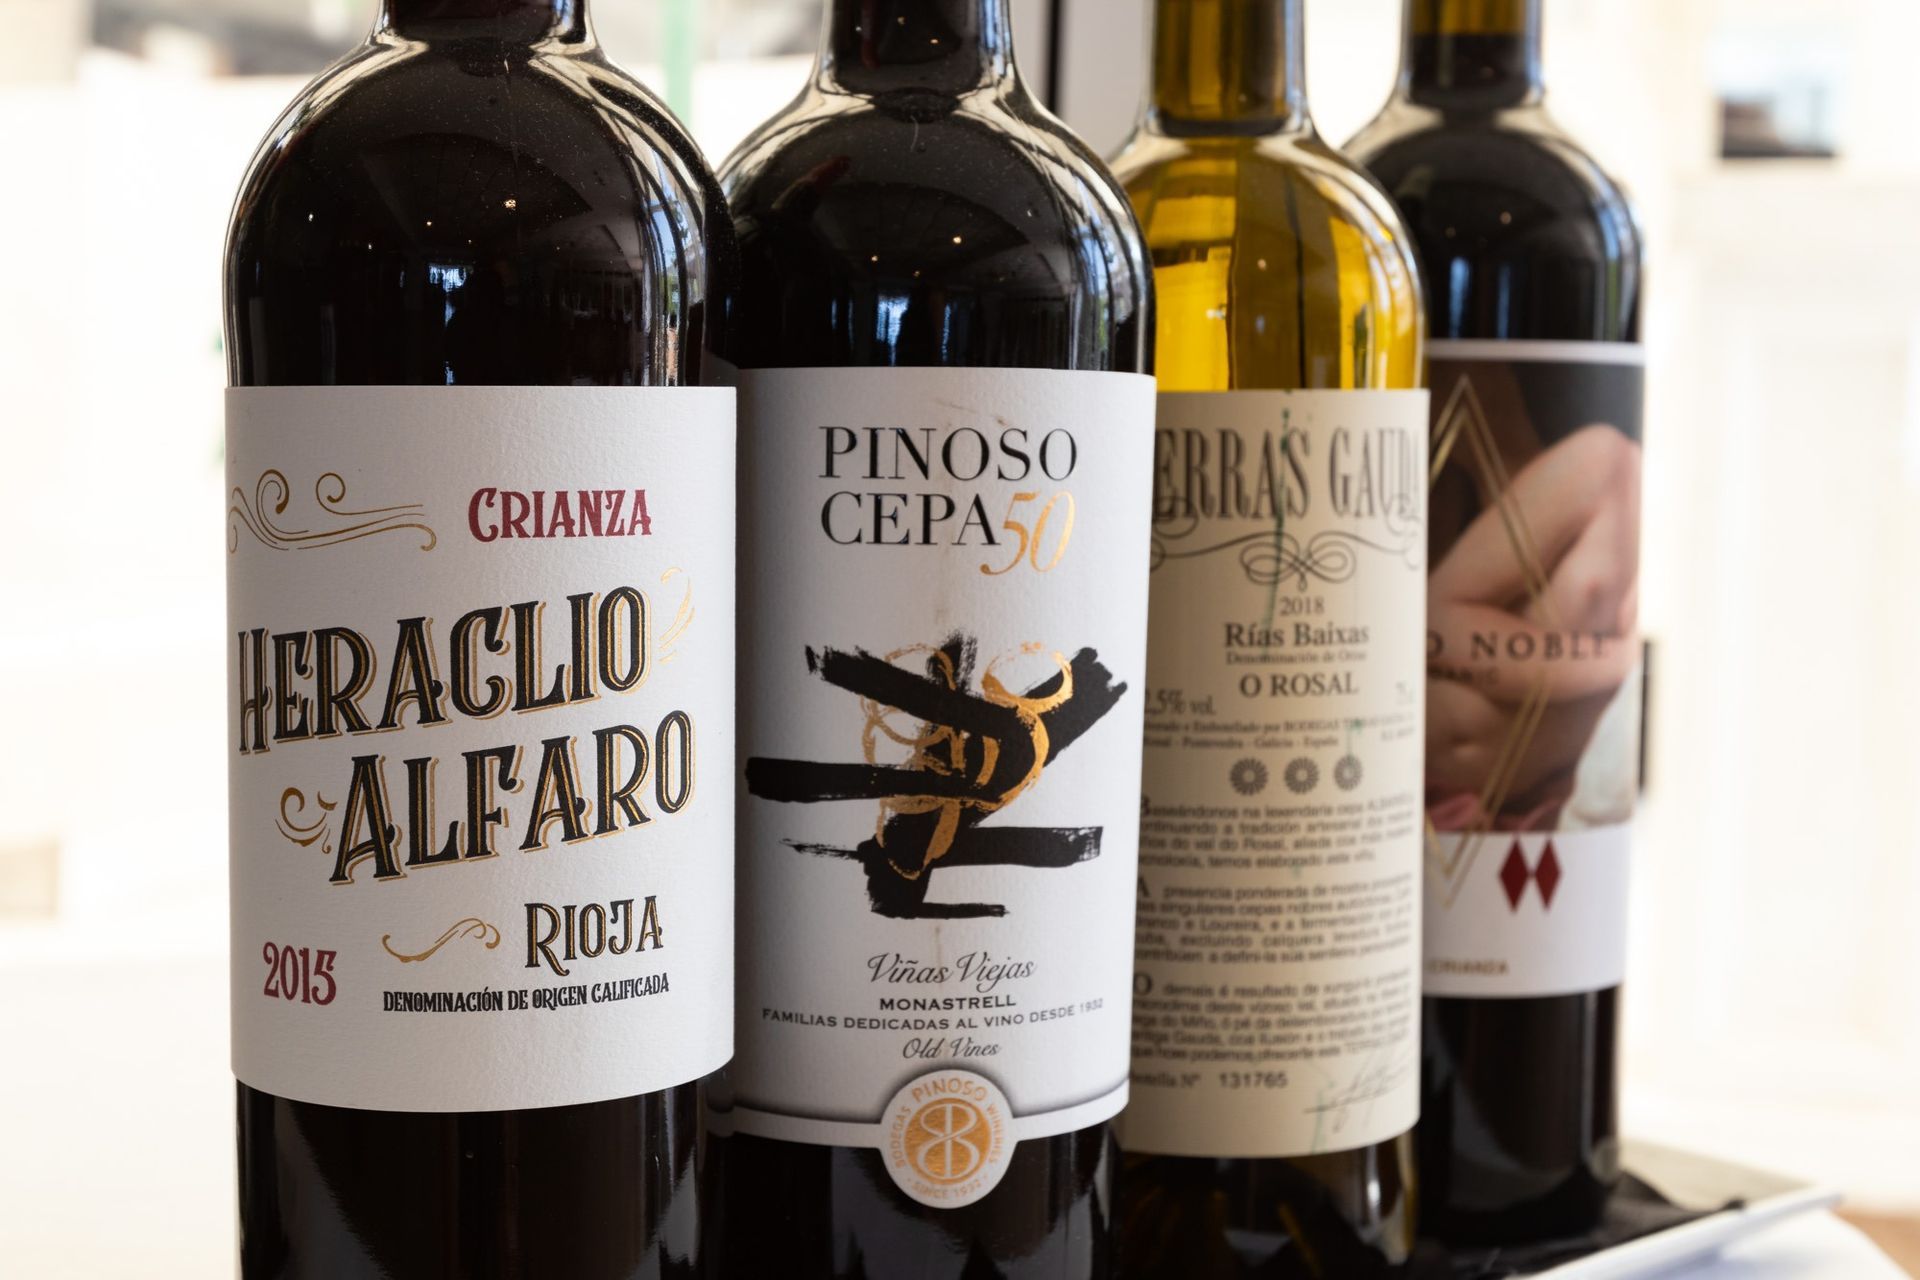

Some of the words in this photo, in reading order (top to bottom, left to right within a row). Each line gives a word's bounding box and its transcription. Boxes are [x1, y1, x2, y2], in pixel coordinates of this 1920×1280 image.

[818, 426, 1078, 481] PINOSO
[467, 487, 652, 543] CRIANZA
[820, 491, 1002, 546] CEPA
[979, 491, 1076, 576] 50
[1278, 596, 1325, 617] 2018
[1224, 621, 1285, 649] Rías
[1292, 620, 1370, 648] Baixas
[237, 585, 652, 755] HERACLIO
[1238, 671, 1262, 699] O
[1268, 670, 1361, 699] ROSAL
[328, 709, 697, 885] ALFARO
[524, 894, 664, 977] RIOJA
[262, 941, 338, 1006] 2015
[383, 987, 503, 1013] DENOMINACIÓN
[508, 989, 529, 1010] DE
[532, 984, 587, 1011] ORIGEN
[591, 972, 670, 1003] CALIFICADA
[866, 952, 952, 985] Viñas
[956, 951, 1037, 994] Viejas
[761, 1007, 838, 1028] FAMILIAS
[843, 1016, 949, 1031] DEDICADAS
[955, 1017, 979, 1030] AL
[983, 1013, 1025, 1028] VINO
[1029, 1004, 1075, 1024] DESDE
[1079, 997, 1105, 1014] 1932
[879, 994, 1017, 1012] MONASTRELL
[902, 1036, 947, 1060] Old
[949, 1036, 1002, 1059] Vines
[1218, 1070, 1288, 1089] 131765
[890, 1105, 912, 1169] BODEGAS
[911, 1078, 988, 1103] PINOSO
